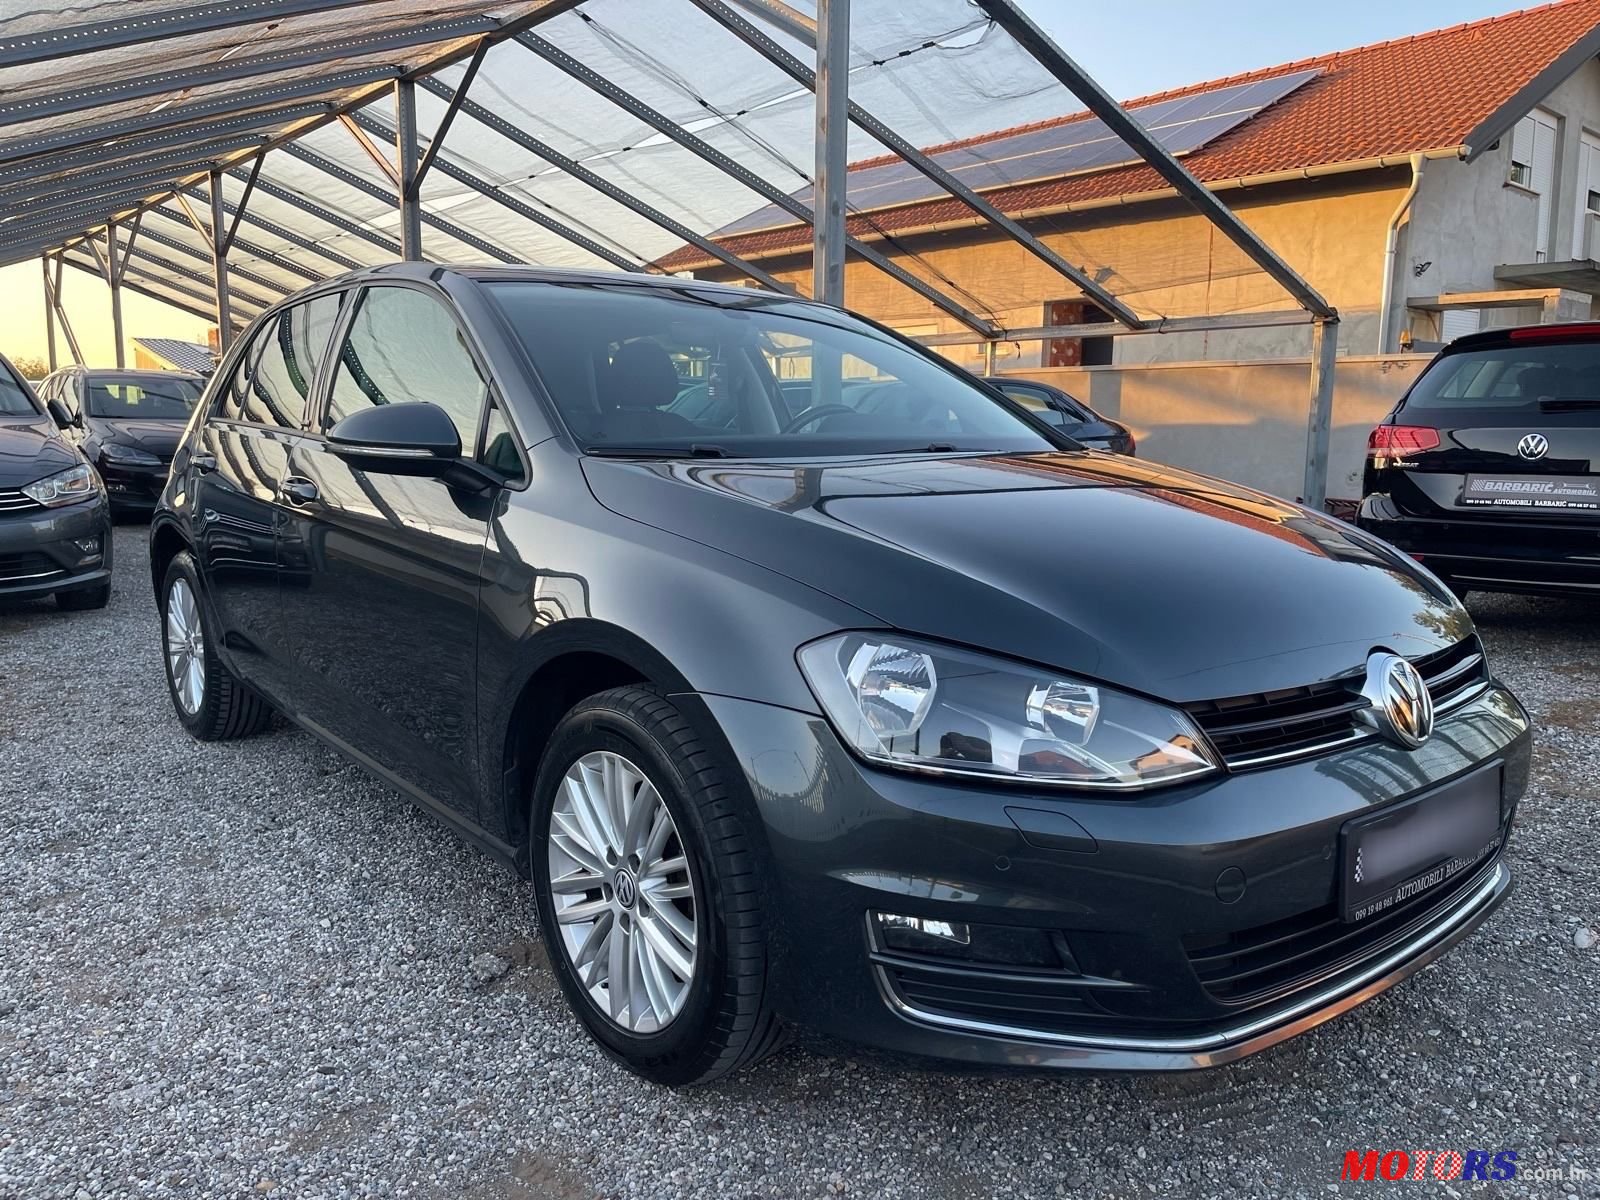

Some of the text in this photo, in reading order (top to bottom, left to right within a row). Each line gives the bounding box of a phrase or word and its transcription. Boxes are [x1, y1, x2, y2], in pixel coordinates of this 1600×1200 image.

[1484, 480, 1554, 493] BARBARIĆ
[1534, 499, 1567, 507] BARBARIĆ
[1355, 908, 1367, 921] 099
[1367, 904, 1375, 916] 19
[1375, 900, 1383, 912] 48
[1395, 868, 1444, 903] AUTOMOBILI
